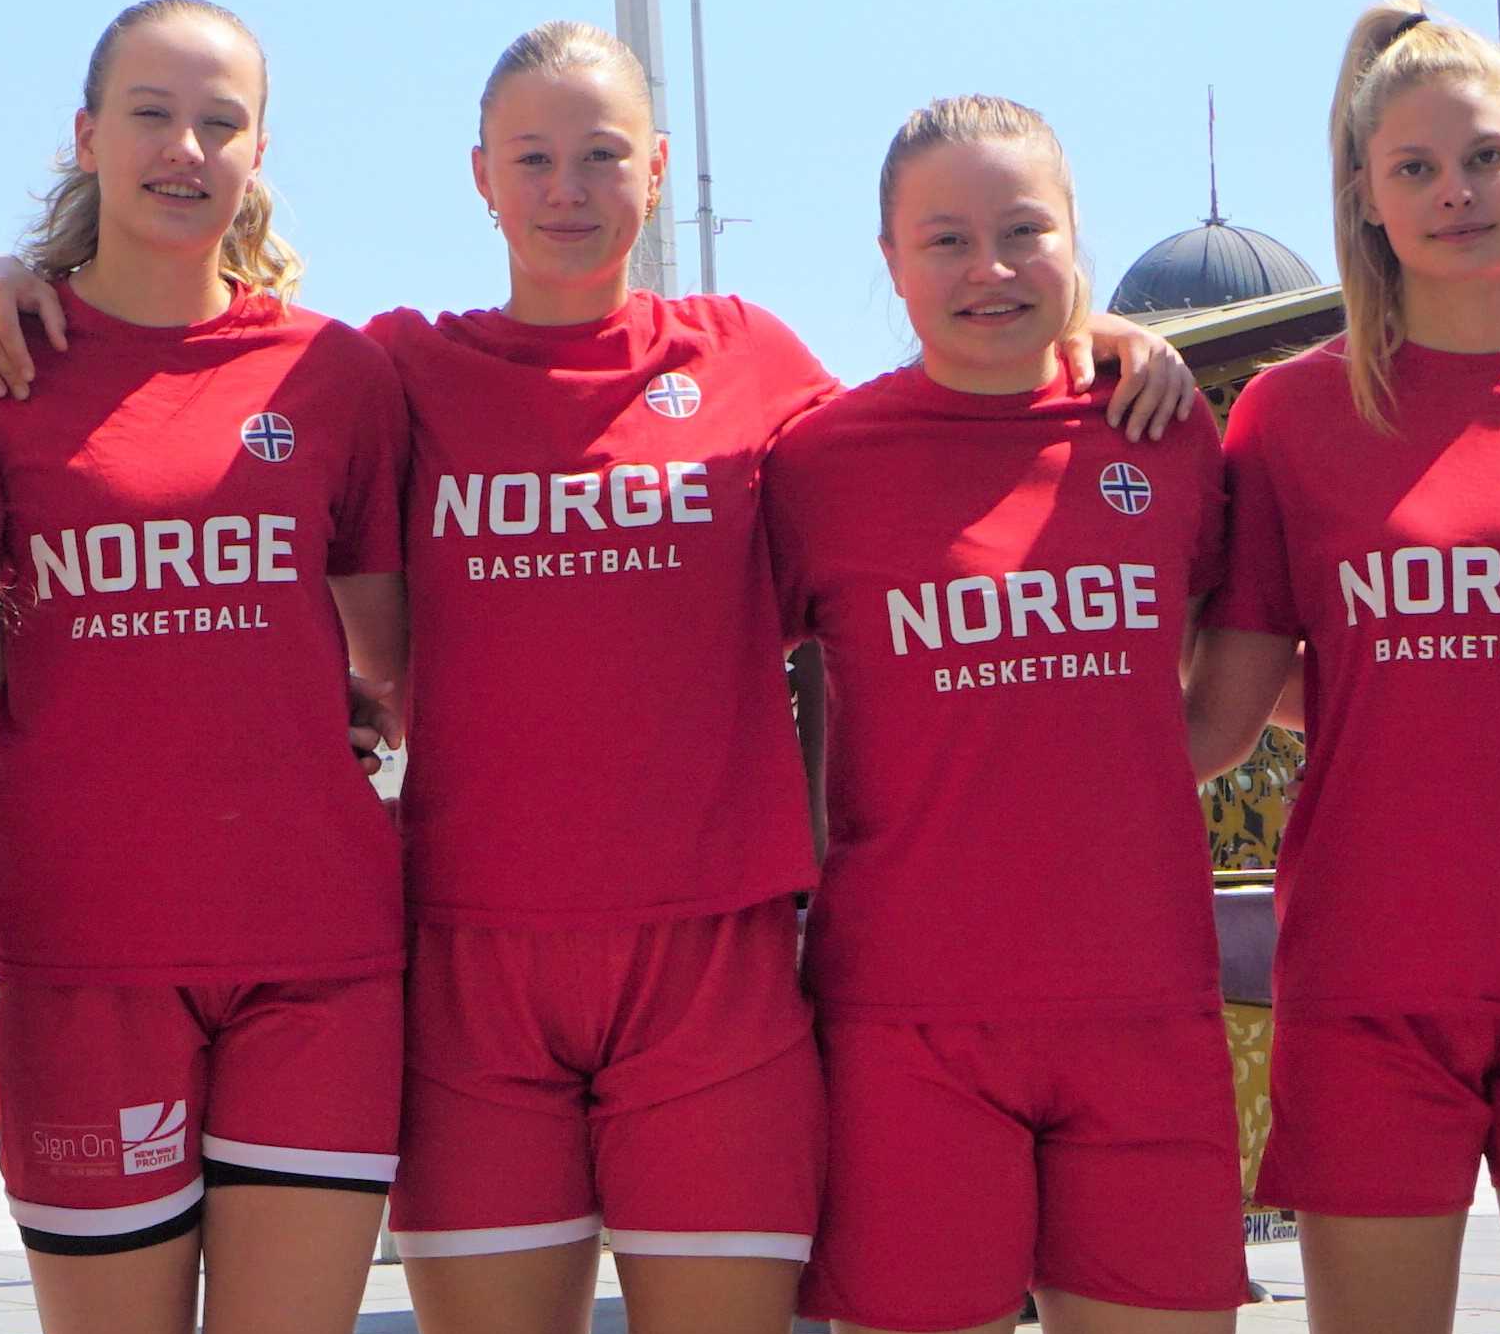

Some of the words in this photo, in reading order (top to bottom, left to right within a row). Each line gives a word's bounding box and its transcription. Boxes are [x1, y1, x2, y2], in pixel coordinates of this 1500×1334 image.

[434, 461, 712, 536] NORGE
[32, 515, 297, 598] NORGE
[469, 546, 680, 579] BASKETBALL
[73, 605, 267, 637] BASKETBALL
[887, 564, 1158, 655] NORGE
[936, 652, 1130, 691] BASKETBALL
[32, 1131, 75, 1161] Sign
[81, 1133, 115, 1158] On
[135, 1154, 177, 1168] PROFILE
[1244, 1213, 1271, 1243] РИК
